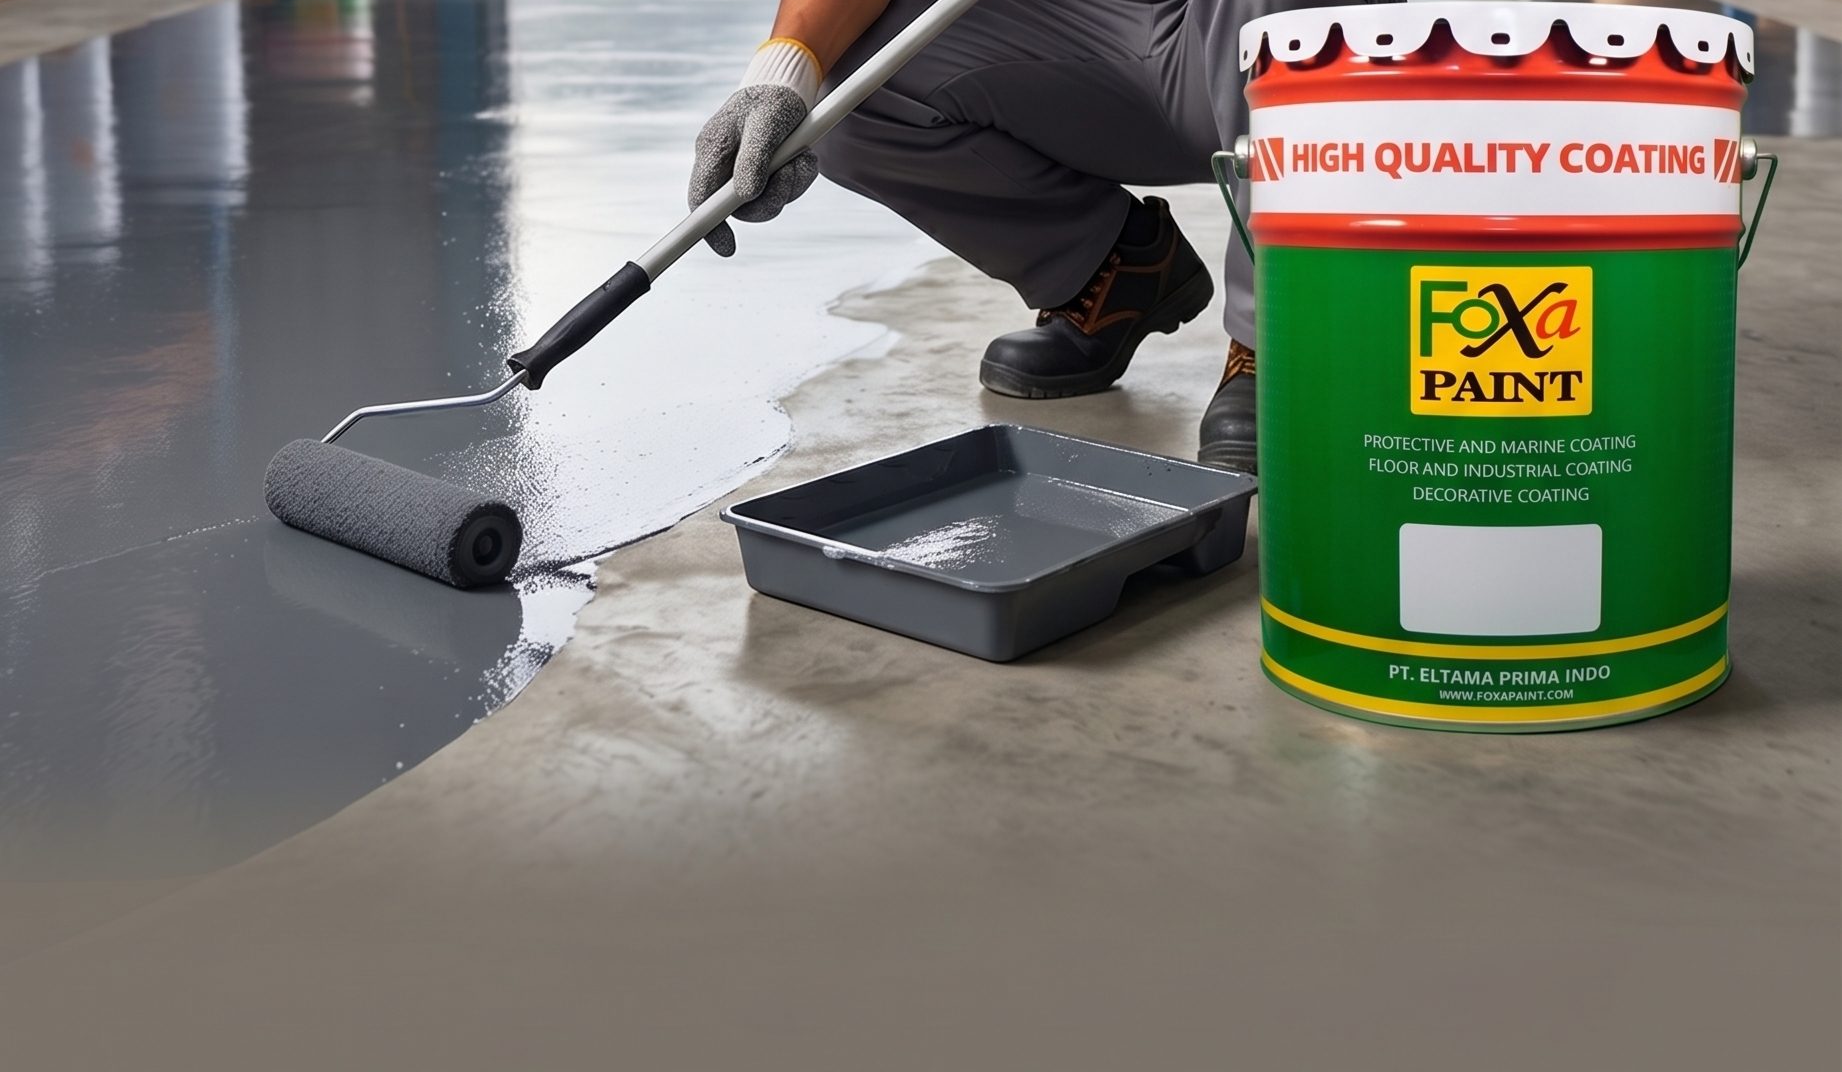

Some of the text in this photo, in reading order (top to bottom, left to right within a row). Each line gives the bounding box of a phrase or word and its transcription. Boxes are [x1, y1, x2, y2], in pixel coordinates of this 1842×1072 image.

[1292, 142, 1706, 179] HIGH QUALITY COATING
[1419, 369, 1582, 404] PAINT
[1364, 434, 1636, 454] PROTECTIVE AND MARINE COATING
[1369, 457, 1632, 478] FLOOR AND INDUSTRIAL COATING
[1413, 486, 1590, 503] DECORATIVE COATING
[1389, 664, 1611, 686] PT. ELTAMA PRIMA INDO
[1439, 689, 1574, 701] WWW.FOXAPAINT.COM
